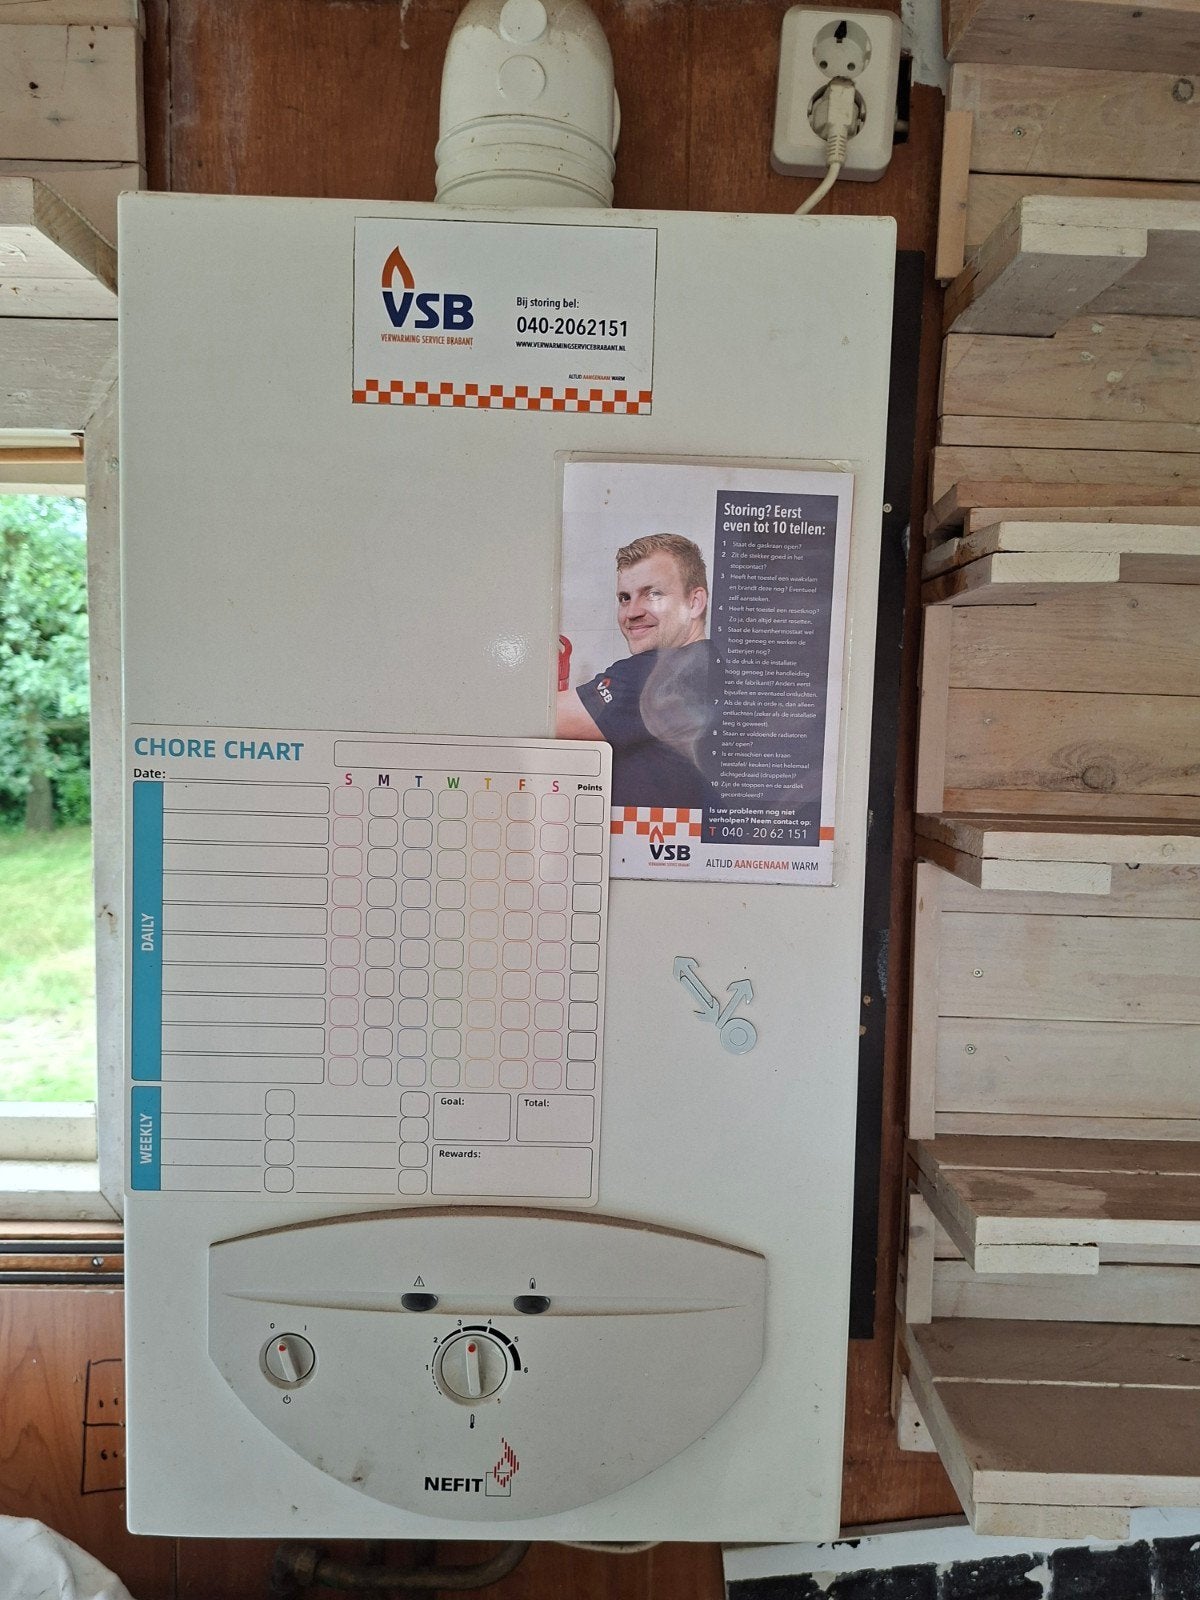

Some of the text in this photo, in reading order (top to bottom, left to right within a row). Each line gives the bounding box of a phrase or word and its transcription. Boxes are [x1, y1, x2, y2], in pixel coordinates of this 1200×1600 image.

[516, 297, 579, 310] Bij storing bel:
[382, 291, 474, 330] VSB
[516, 316, 627, 337] 040-2062151
[381, 333, 473, 346] VERWARMING SERVICE BRABANT
[723, 502, 802, 520] Storing? Eerst
[722, 520, 826, 535] even tot 10 tellen:
[770, 553, 786, 561] goed
[755, 648, 770, 656] nog?
[597, 682, 613, 702] VSB
[134, 737, 304, 761] CHORE CHART
[133, 768, 166, 779] Date:
[378, 774, 390, 786] M
[447, 777, 460, 789] W
[577, 783, 603, 792] Points
[729, 807, 763, 816] probleem
[708, 816, 748, 824] verholpen?
[721, 826, 743, 837] 040
[752, 827, 767, 838] 20
[769, 828, 783, 838] 62
[788, 828, 806, 839] 151
[649, 844, 691, 861] VSB
[706, 858, 819, 871] ALTIJD AANGENAAM WARM
[141, 913, 154, 952] DAILY
[440, 1097, 465, 1106] Goal:
[524, 1099, 550, 1107] Total:
[140, 1113, 153, 1164] WEEKLY
[439, 1150, 481, 1158] Rewards:
[424, 1476, 483, 1492] NEFIT
